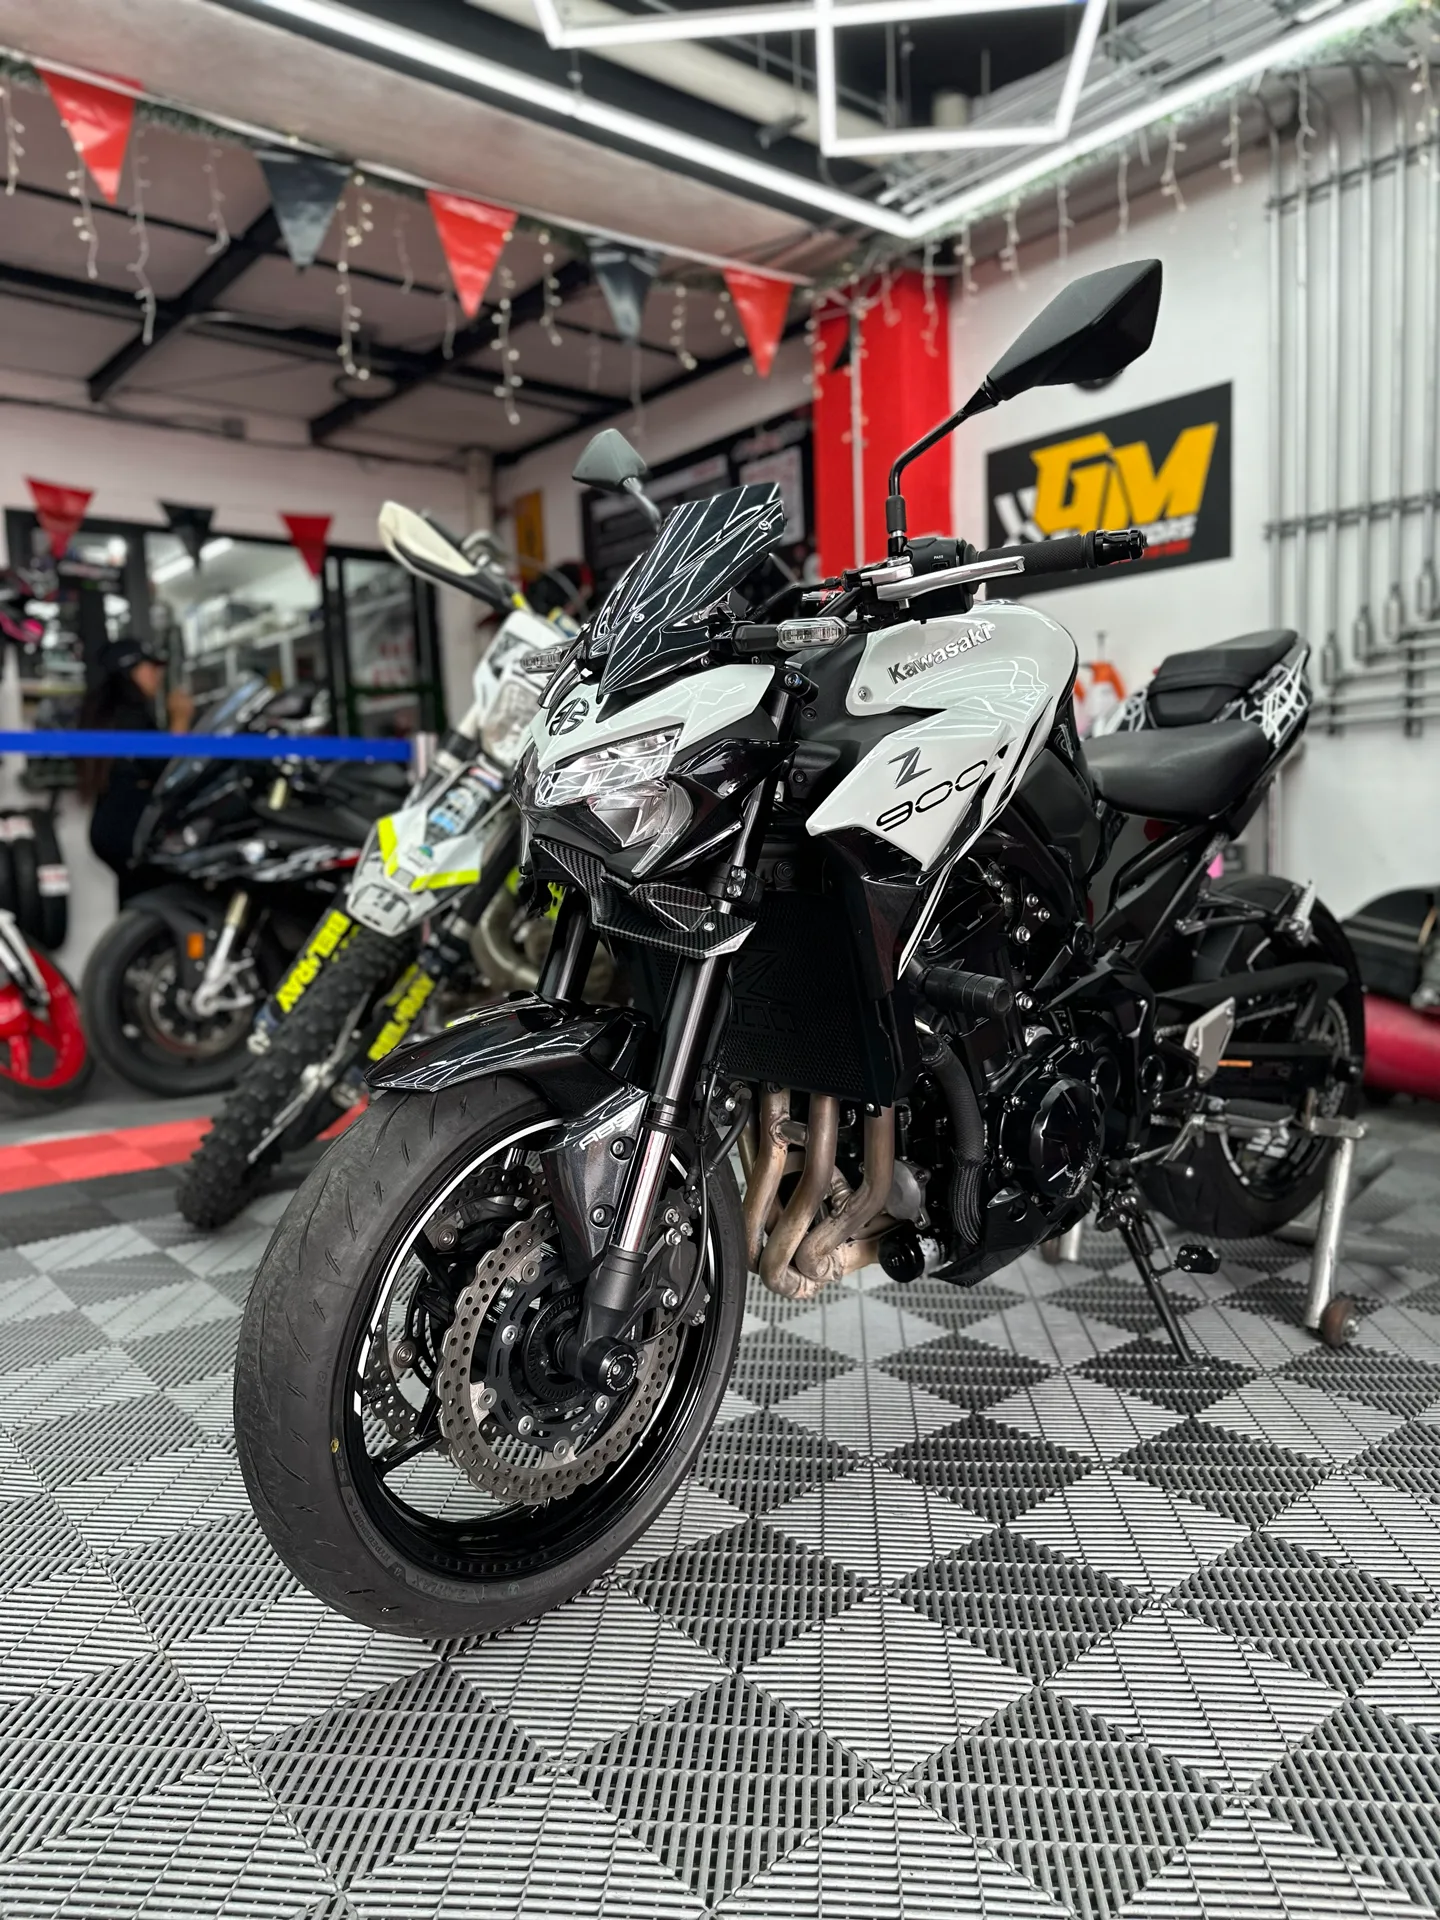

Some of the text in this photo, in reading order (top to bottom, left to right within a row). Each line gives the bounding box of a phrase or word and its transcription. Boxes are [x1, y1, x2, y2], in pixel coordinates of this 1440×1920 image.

[1029, 421, 1219, 537] GM
[887, 622, 993, 684] Kawasaki
[876, 760, 988, 833] 900
[579, 1108, 633, 1151] ABS
